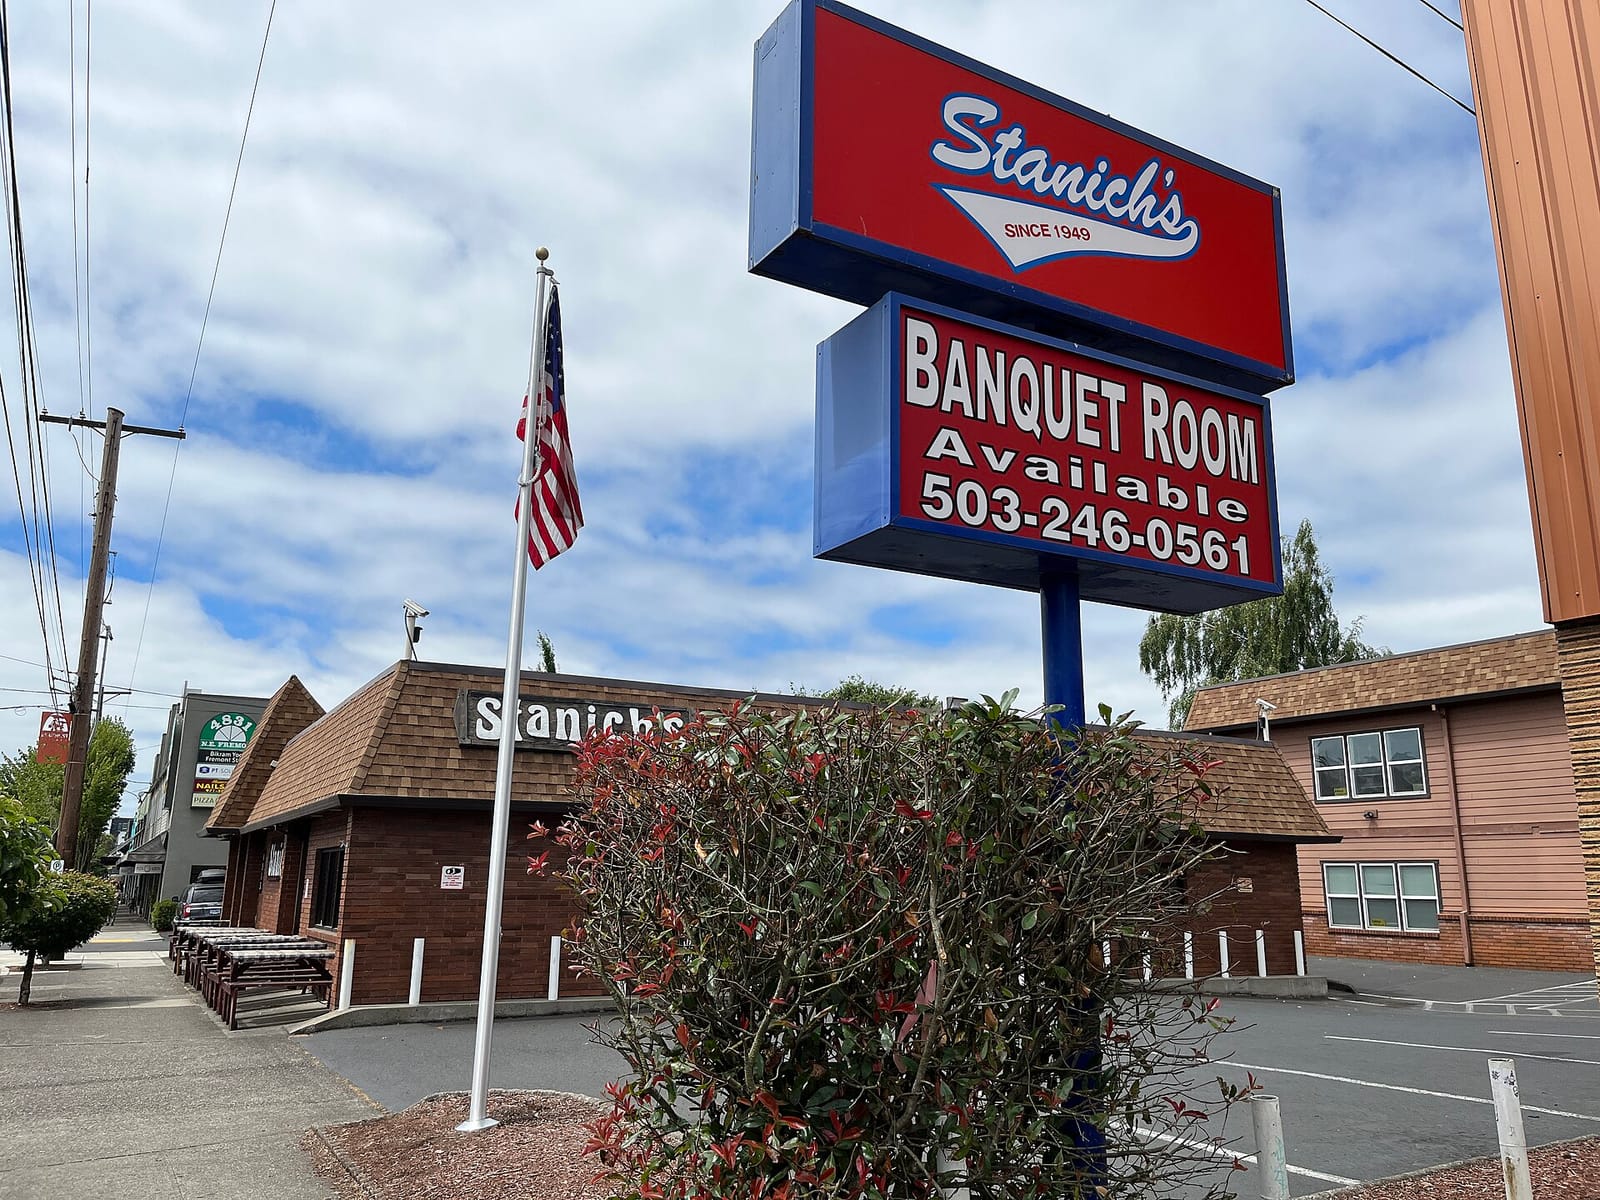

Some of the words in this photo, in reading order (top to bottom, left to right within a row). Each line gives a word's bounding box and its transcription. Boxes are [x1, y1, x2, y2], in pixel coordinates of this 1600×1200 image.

[931, 95, 1188, 236] Stanich's
[1004, 223, 1052, 238] SINCE
[1053, 224, 1091, 241] 1949
[905, 316, 1127, 453] BANQUET
[1142, 381, 1260, 486] ROOM
[920, 472, 1250, 576] 503-246-0561
[924, 427, 1250, 523] Available
[210, 714, 252, 732] 4831
